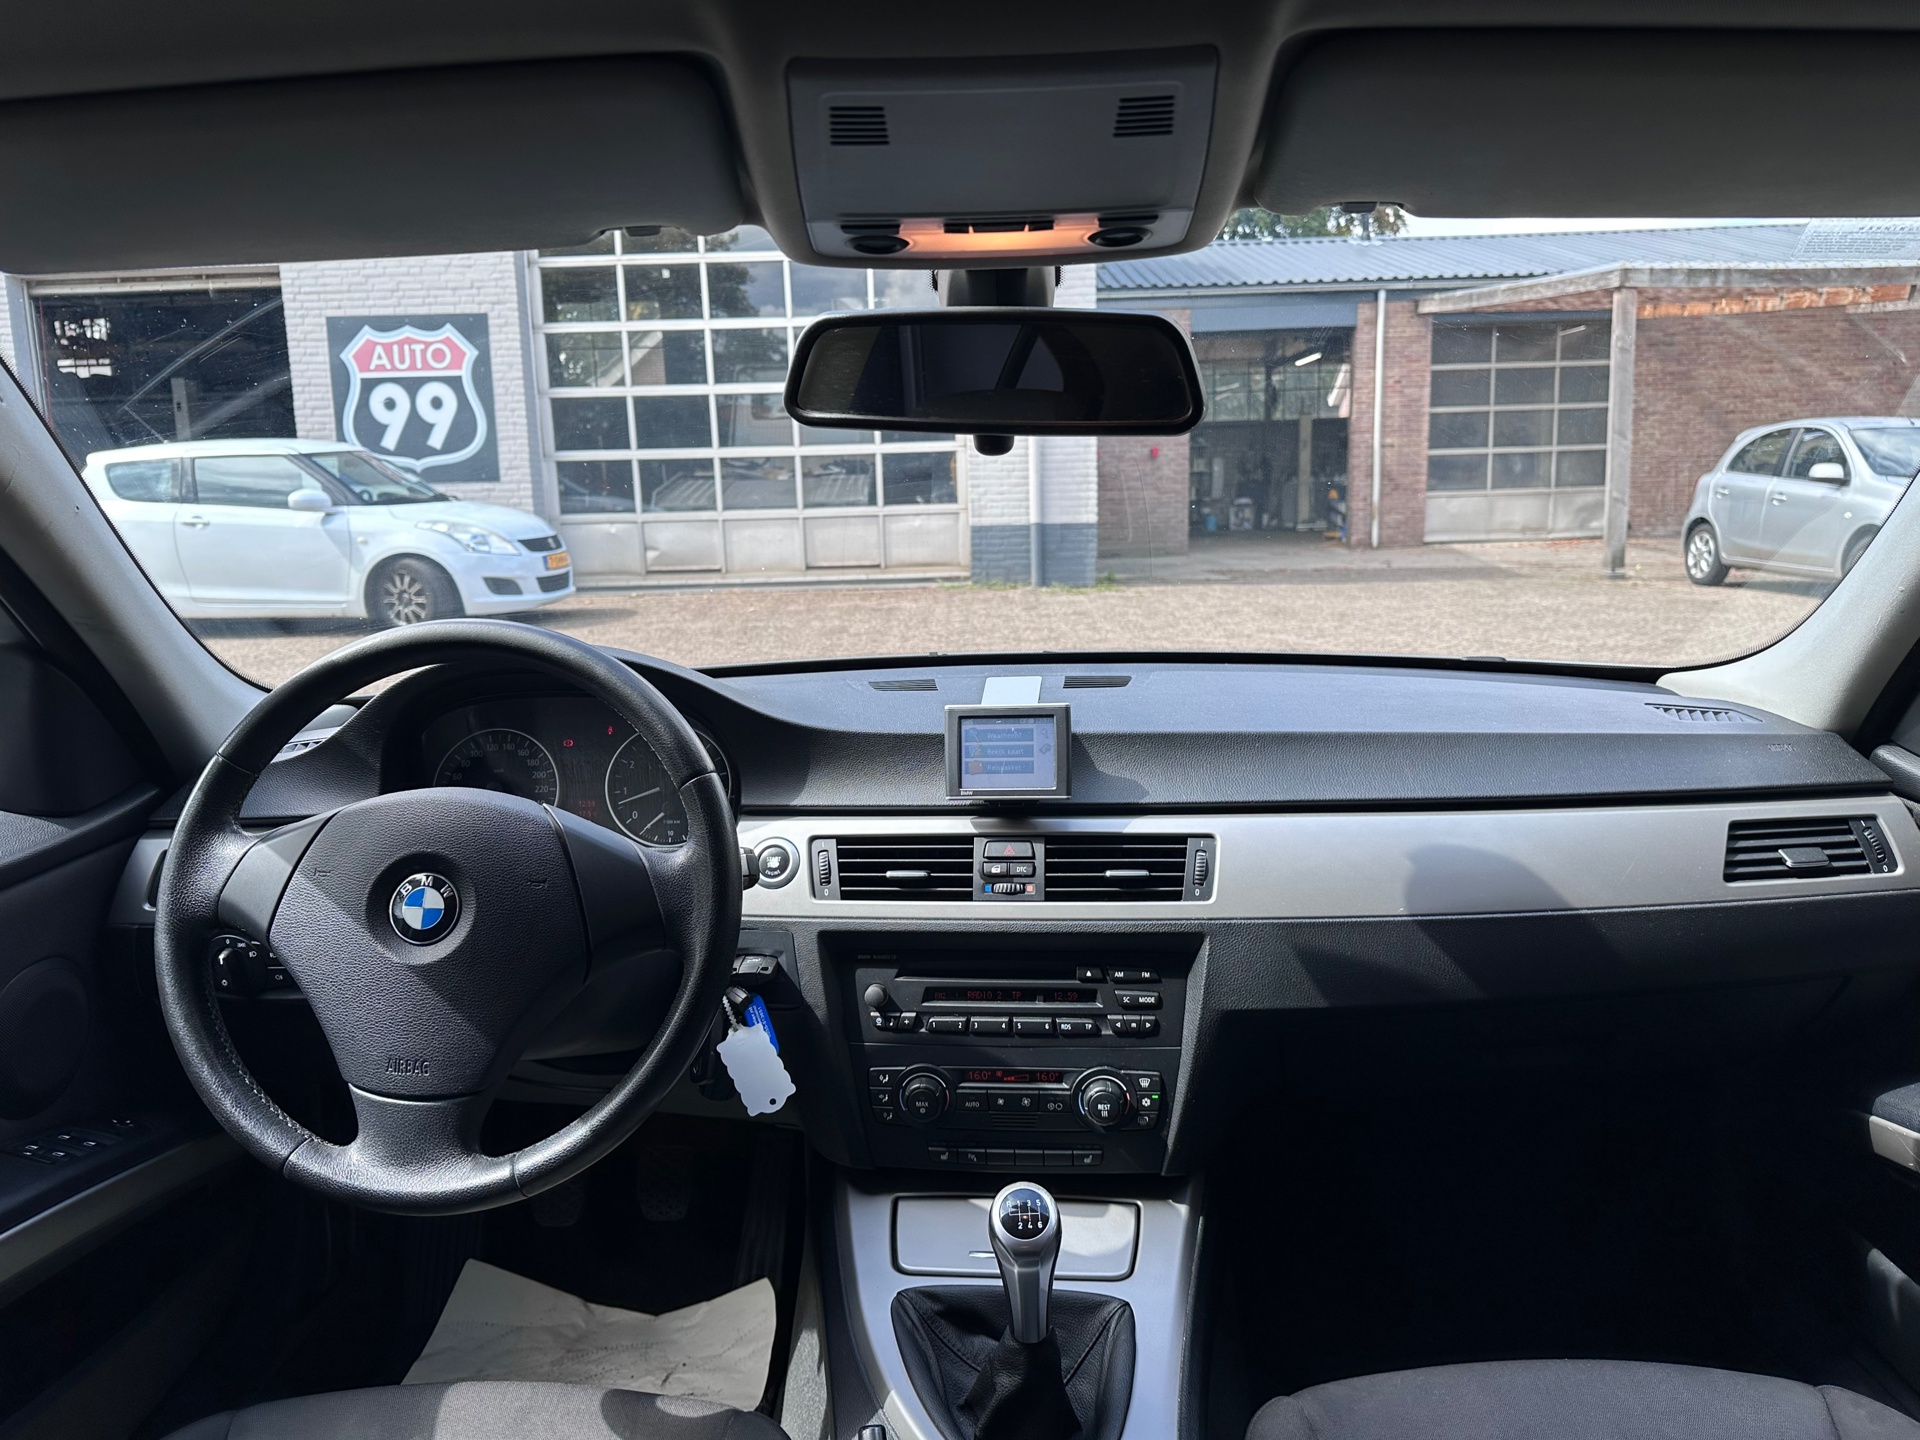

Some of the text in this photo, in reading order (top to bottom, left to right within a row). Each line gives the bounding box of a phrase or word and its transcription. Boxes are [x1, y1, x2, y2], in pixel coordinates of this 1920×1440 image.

[369, 342, 451, 371] AUTO
[368, 380, 458, 451] 99
[532, 771, 546, 779] 200
[534, 785, 549, 793] 220
[632, 811, 638, 819] 0
[400, 875, 453, 899] BMW
[967, 991, 992, 999] RADIO
[997, 991, 1002, 999] 2
[1054, 992, 1078, 1000] 12:59
[385, 1058, 430, 1077] AIRBAG
